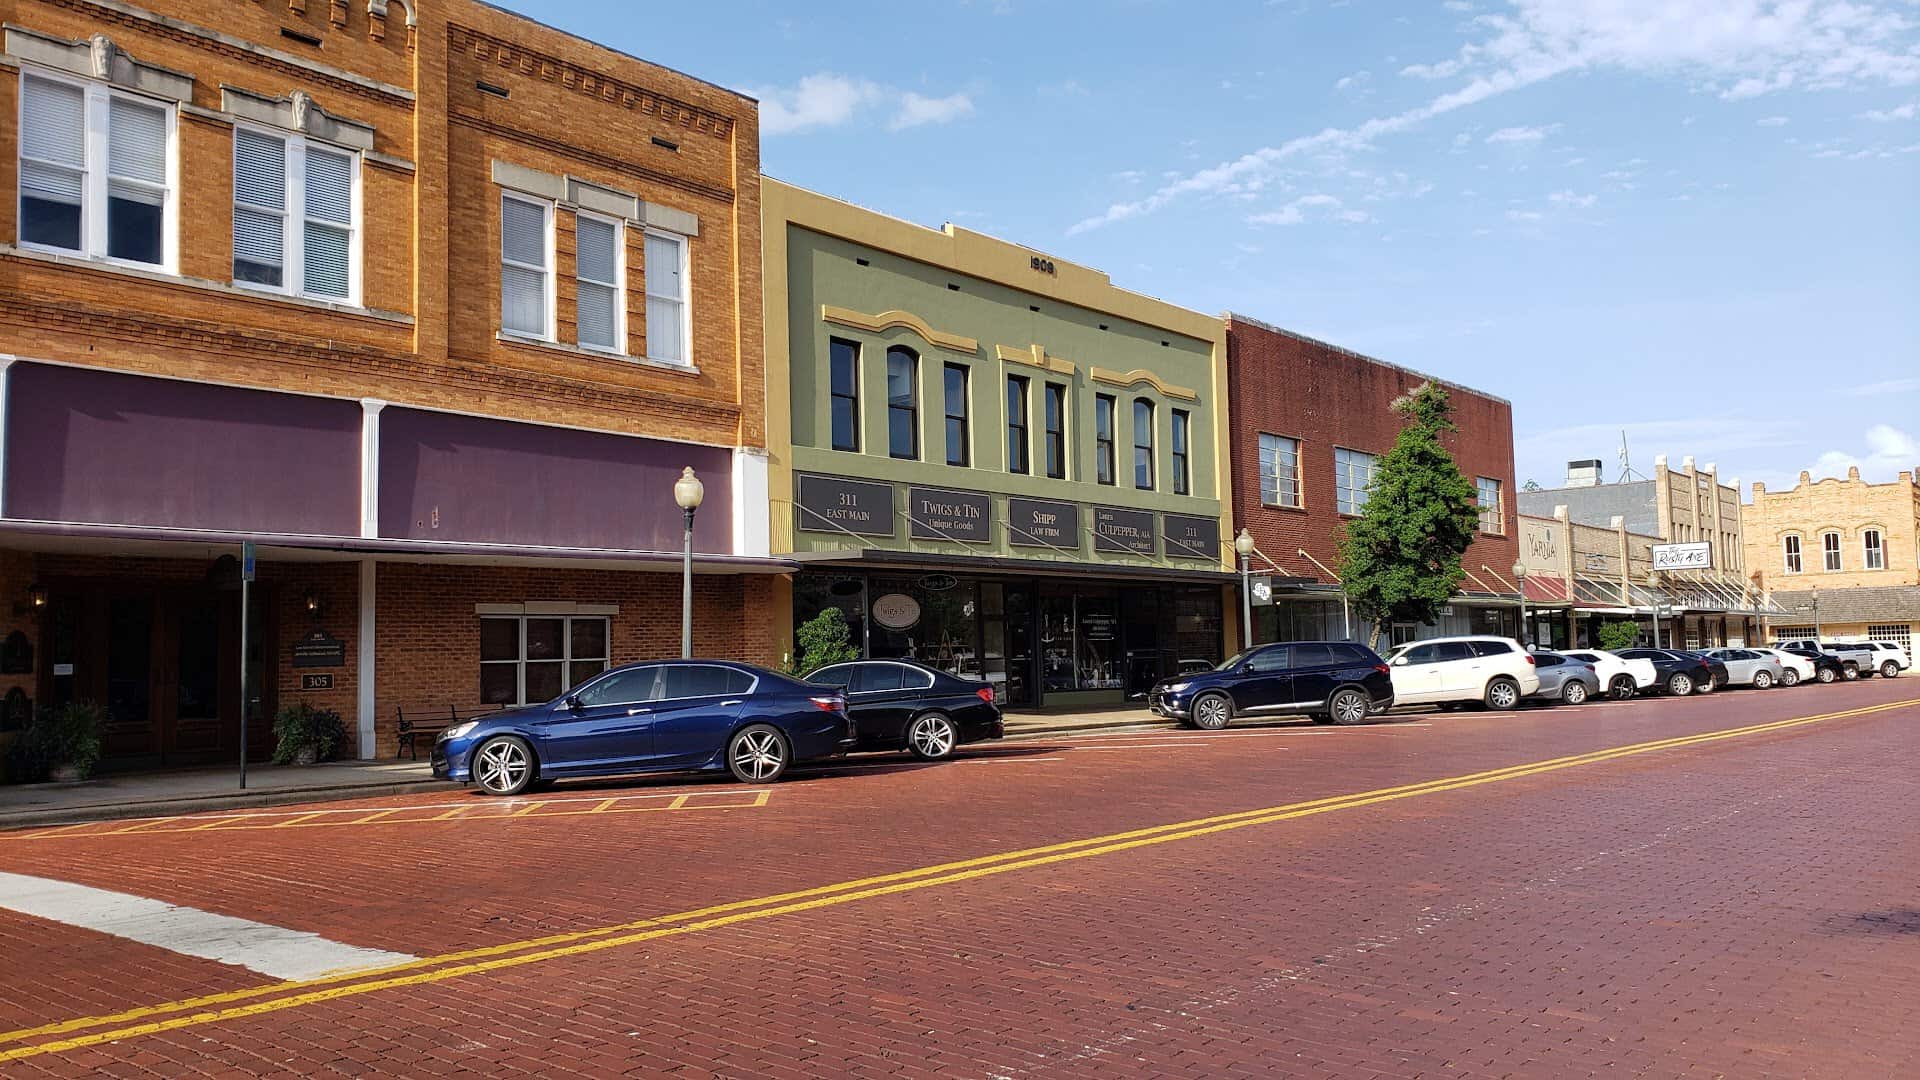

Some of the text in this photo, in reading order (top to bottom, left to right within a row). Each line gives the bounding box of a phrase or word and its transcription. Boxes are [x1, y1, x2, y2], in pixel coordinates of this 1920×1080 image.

[839, 492, 857, 506] 311
[826, 508, 870, 521] EAST MAIN
[921, 500, 980, 520] TWIGS & TIN
[1032, 510, 1057, 525] SHIPP
[928, 518, 974, 530] Unique Goods
[1030, 526, 1060, 537] LAW FIRM
[1184, 526, 1198, 537] 311
[308, 676, 328, 688] 305
